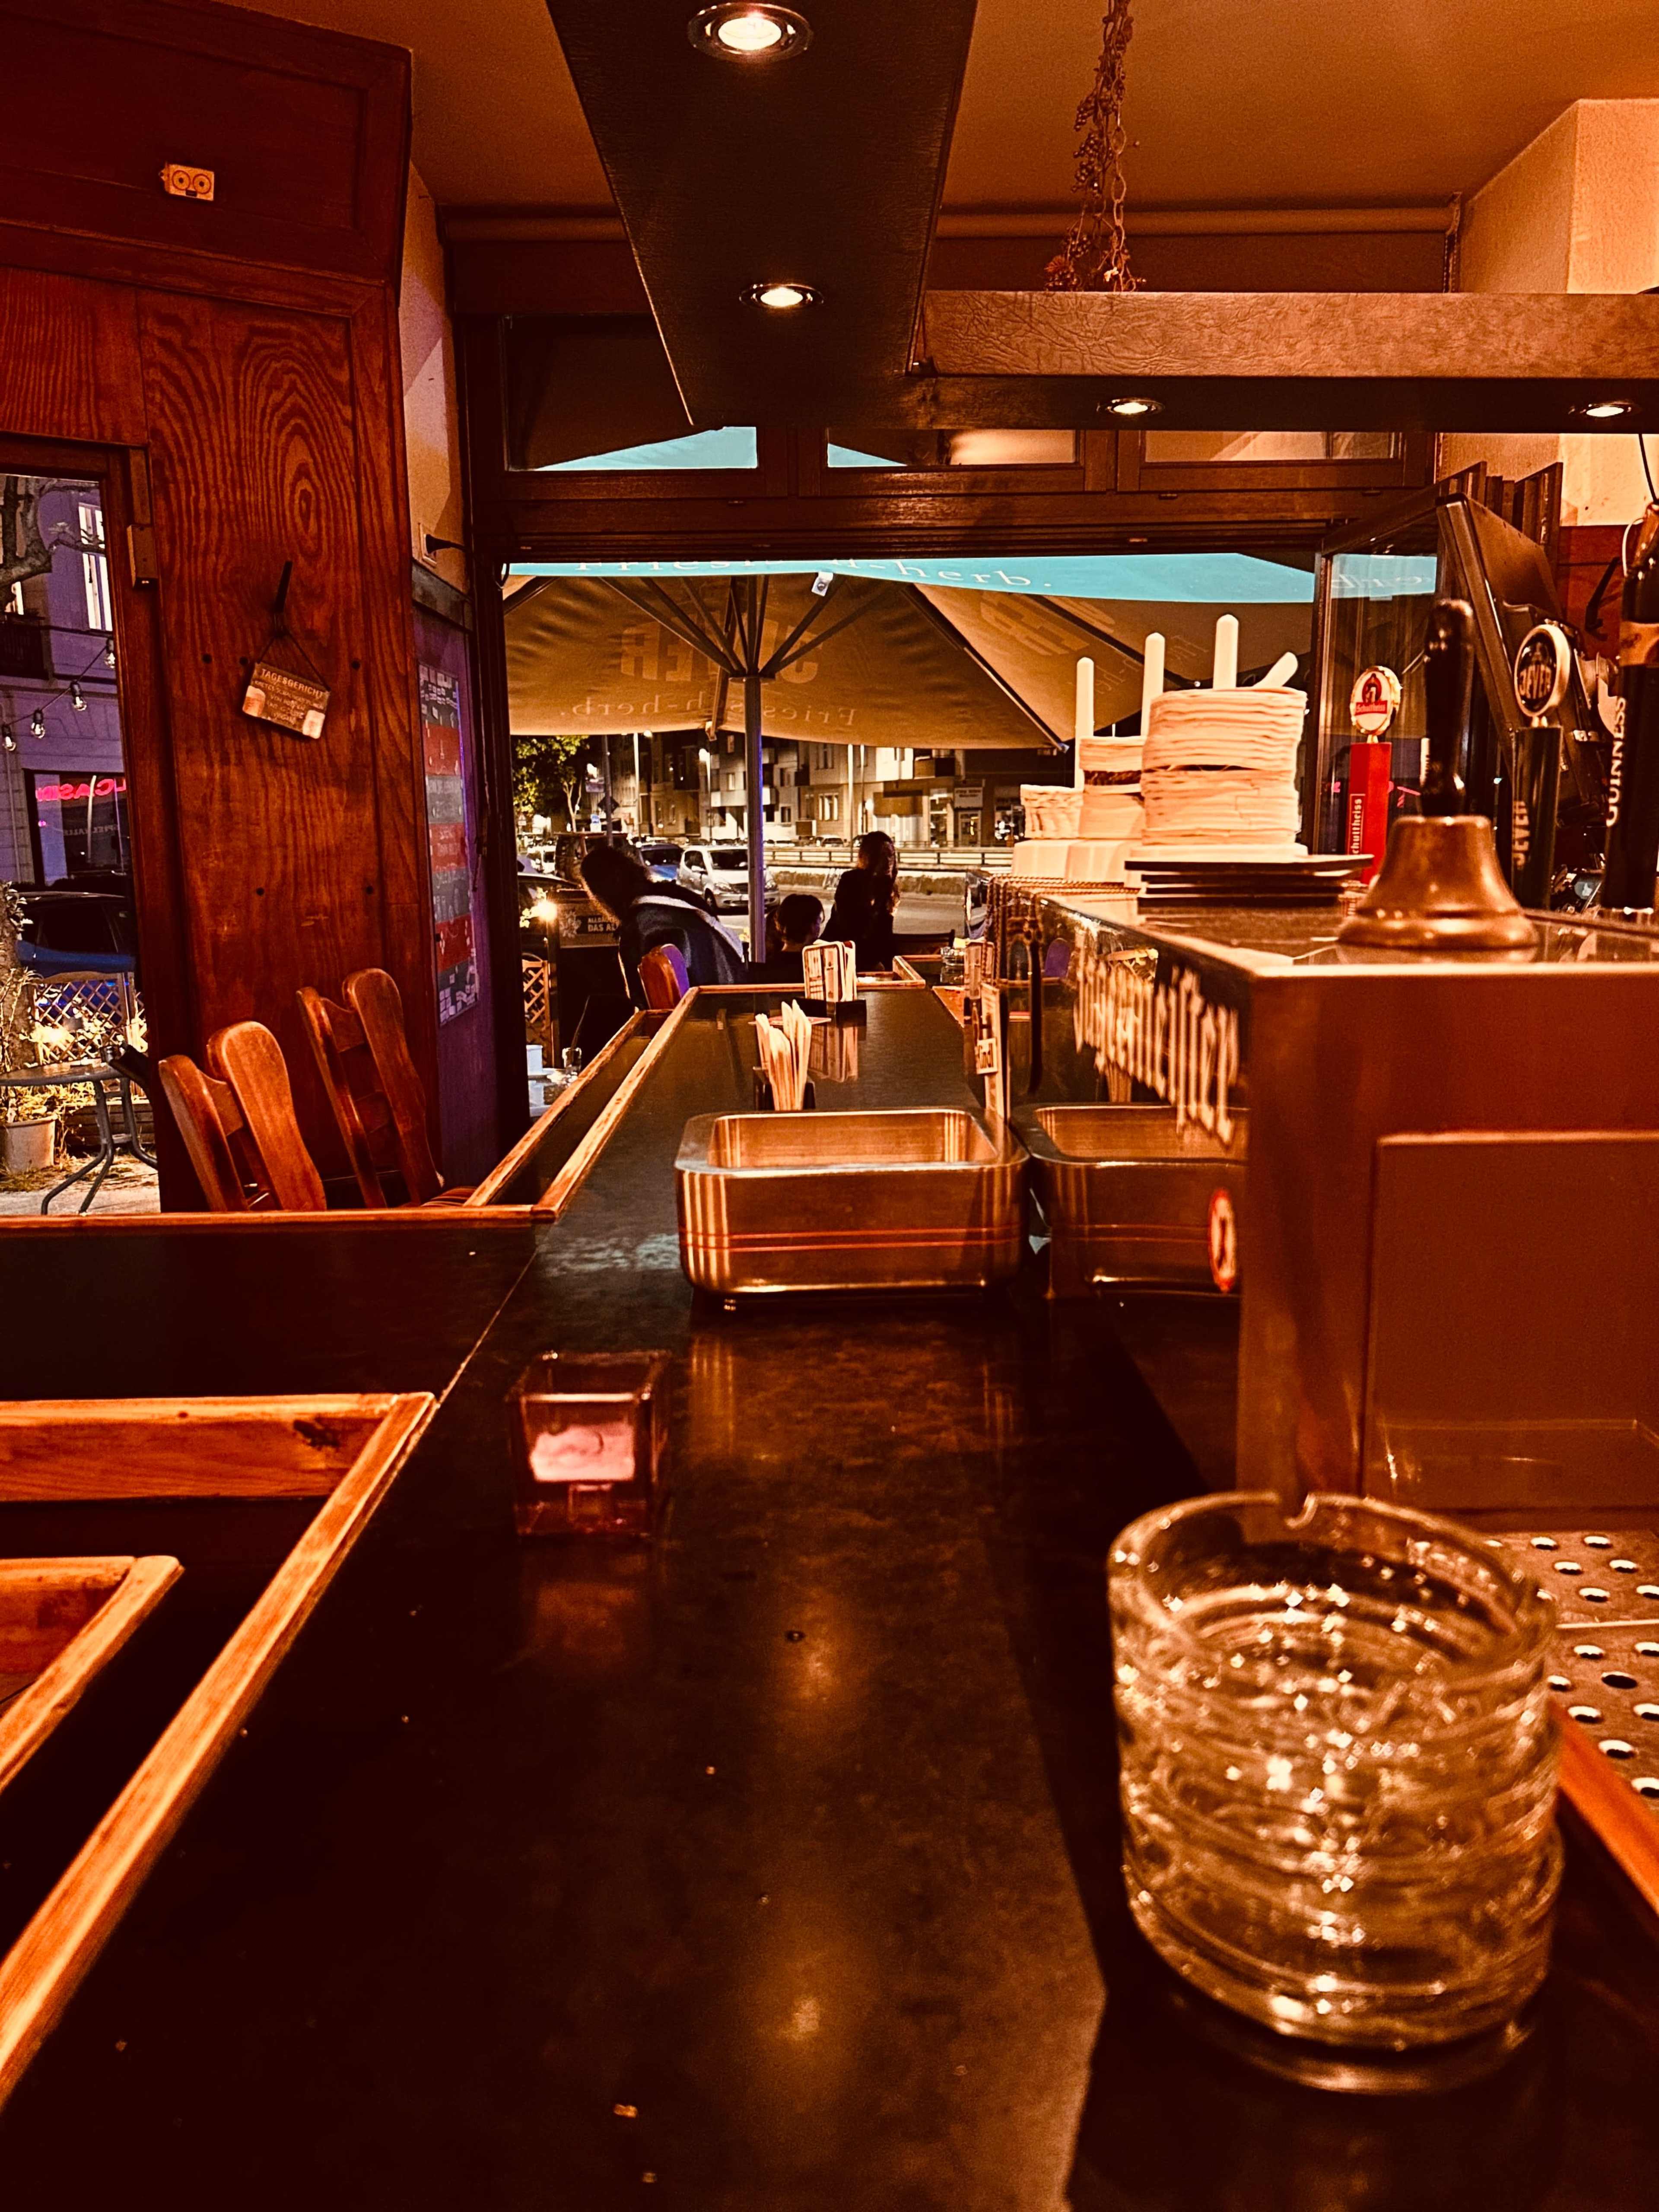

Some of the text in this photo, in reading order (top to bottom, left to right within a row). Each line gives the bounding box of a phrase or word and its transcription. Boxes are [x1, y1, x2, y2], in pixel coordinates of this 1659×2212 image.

[261, 668, 323, 698] TAGESGERICHT
[1605, 697, 1626, 827] GUINNESS
[1350, 798, 1362, 855] chultheiss
[1513, 801, 1531, 870] JEVER
[588, 924, 604, 932] DAS
